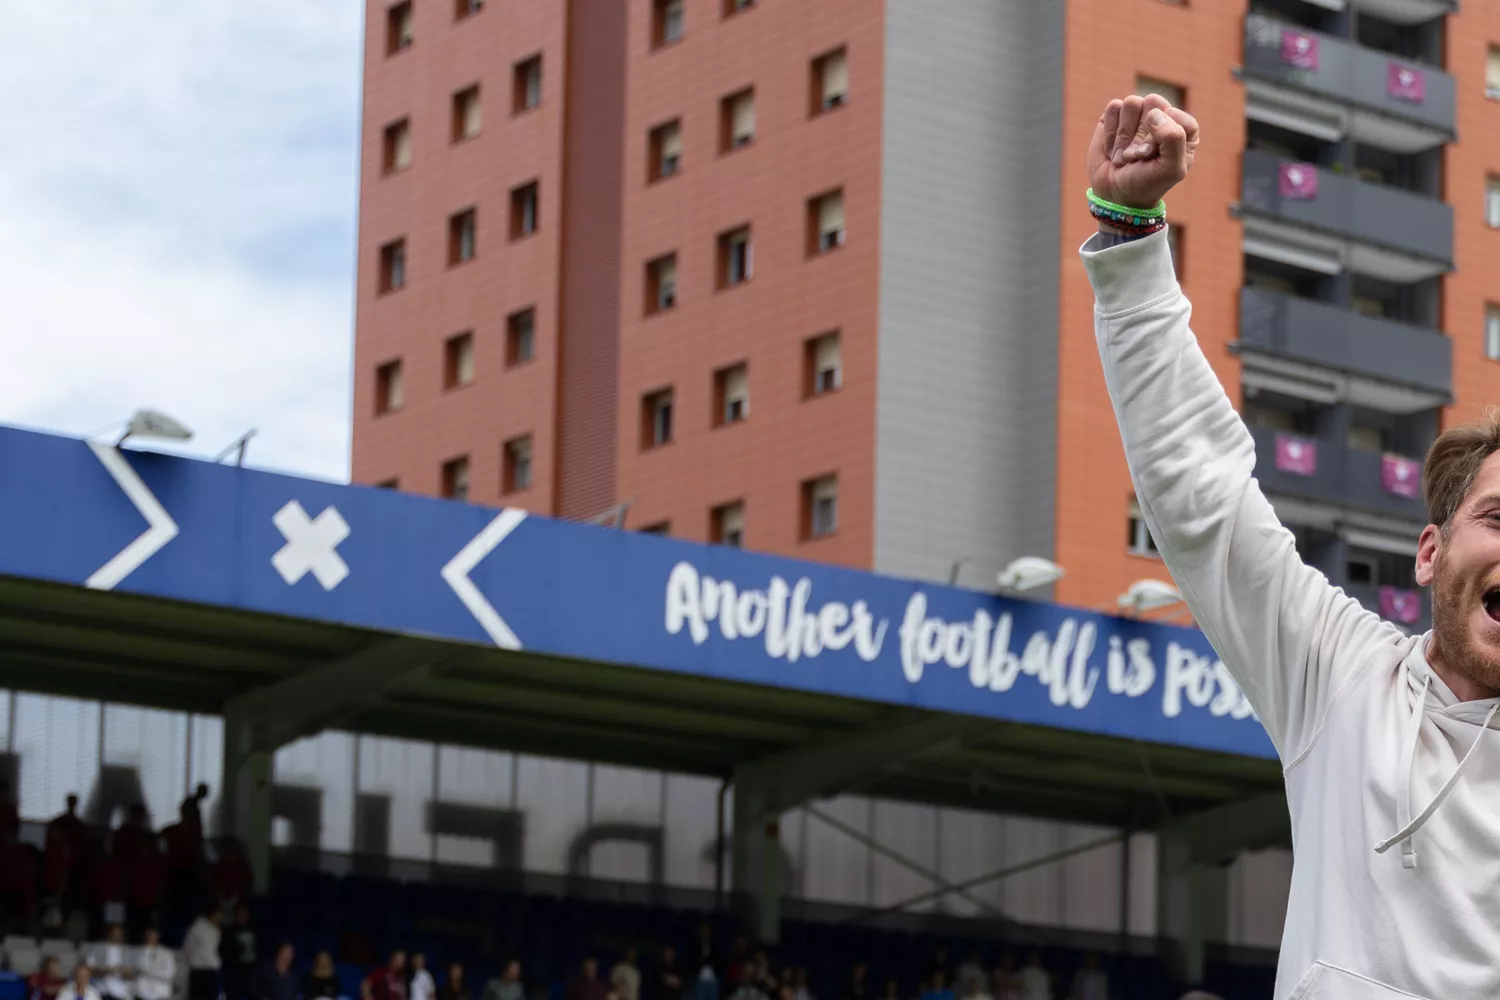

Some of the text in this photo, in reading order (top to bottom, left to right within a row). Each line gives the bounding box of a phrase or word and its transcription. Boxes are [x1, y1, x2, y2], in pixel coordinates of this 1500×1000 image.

[666, 561, 889, 662] Another
[899, 592, 1099, 710] football
[1107, 635, 1156, 698] is
